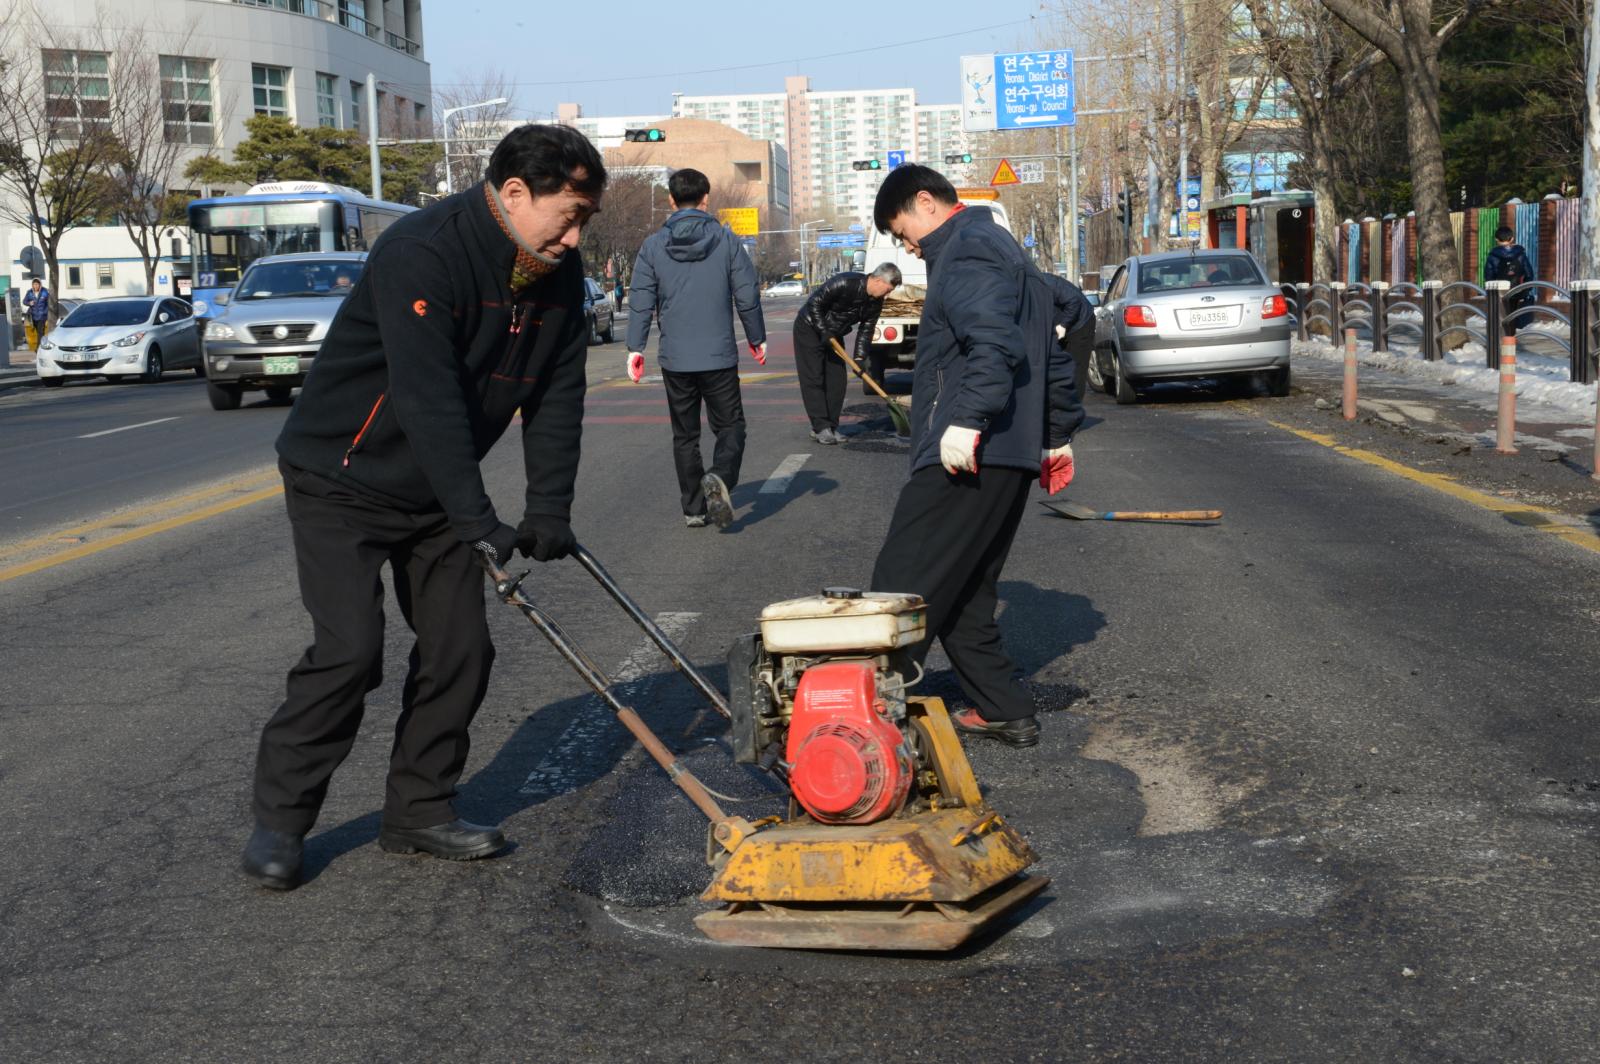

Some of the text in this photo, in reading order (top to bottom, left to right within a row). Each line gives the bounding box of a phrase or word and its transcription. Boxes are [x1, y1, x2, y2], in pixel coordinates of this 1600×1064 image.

[1003, 53, 1067, 72] 연수구청
[1004, 73, 1025, 83] Yeonsu
[1028, 72, 1048, 82] District
[1005, 83, 1068, 102] 연수구의회
[1005, 103, 1037, 115] Yeonsu-gu
[1042, 100, 1067, 111] Council
[200, 273, 215, 287] 27
[265, 362, 297, 373] 8799
